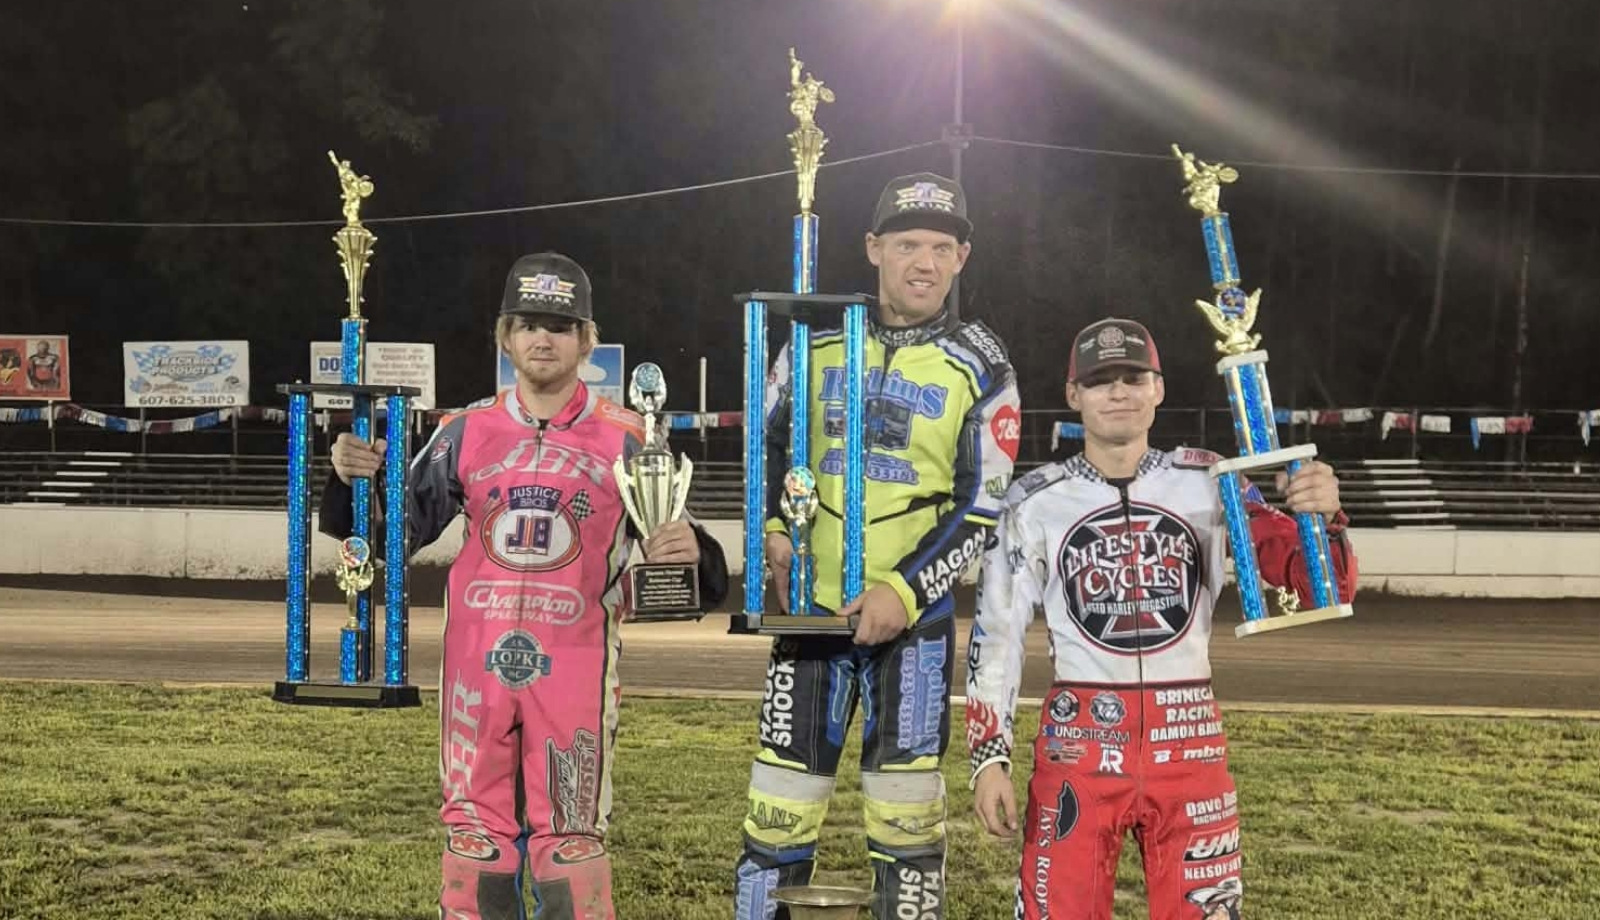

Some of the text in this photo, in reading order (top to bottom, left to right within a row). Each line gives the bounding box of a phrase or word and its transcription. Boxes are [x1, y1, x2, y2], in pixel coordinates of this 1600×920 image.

[961, 327, 998, 365] SHOCKS
[968, 323, 1006, 364] HAGON
[511, 486, 561, 501] JUSTICE
[519, 498, 549, 508] BROS
[918, 526, 987, 591] HAGON
[1066, 531, 1195, 579] LIFESTYLE
[1083, 565, 1181, 597] CYCLES
[471, 588, 577, 615] Champion
[1106, 600, 1137, 616] HARLEY
[490, 651, 546, 669] LOPKE
[771, 657, 795, 748] SHOCK
[1165, 704, 1216, 723] RACIN
